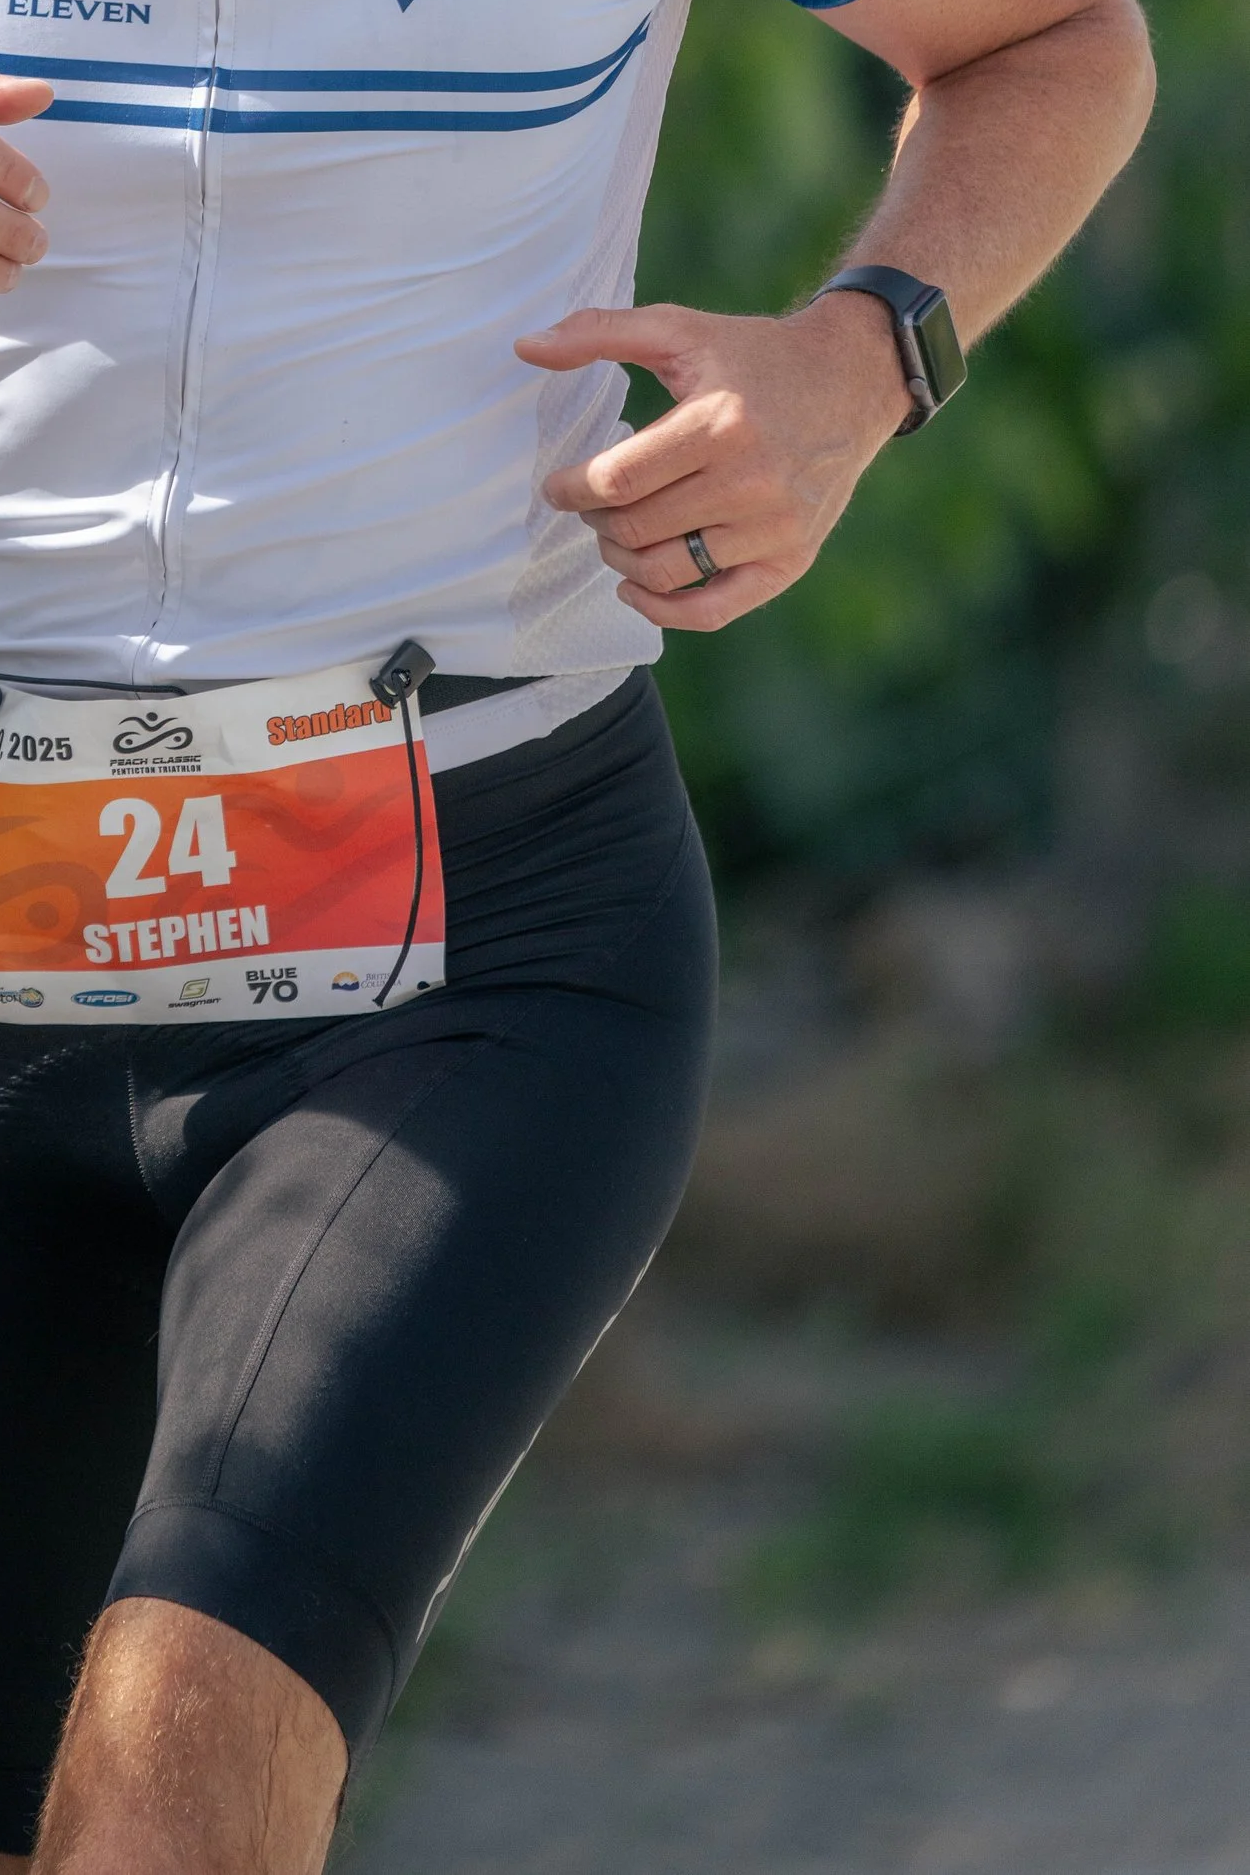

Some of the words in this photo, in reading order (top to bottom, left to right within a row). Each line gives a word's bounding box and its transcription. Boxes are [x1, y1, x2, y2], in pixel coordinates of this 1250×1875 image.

[7, 732, 72, 762] 2025
[110, 758, 148, 767] PEACH
[152, 755, 201, 765] CLASSIC
[111, 767, 155, 775] PENTICTON
[158, 765, 201, 773] TRIATHLON
[99, 794, 237, 899] 24
[83, 905, 270, 964] STEPHEN
[246, 967, 297, 982] BLUE
[366, 973, 391, 981] BRITIS
[76, 994, 134, 1003] TIFOSI
[247, 980, 298, 1005] 70
[168, 997, 219, 1008] swagman
